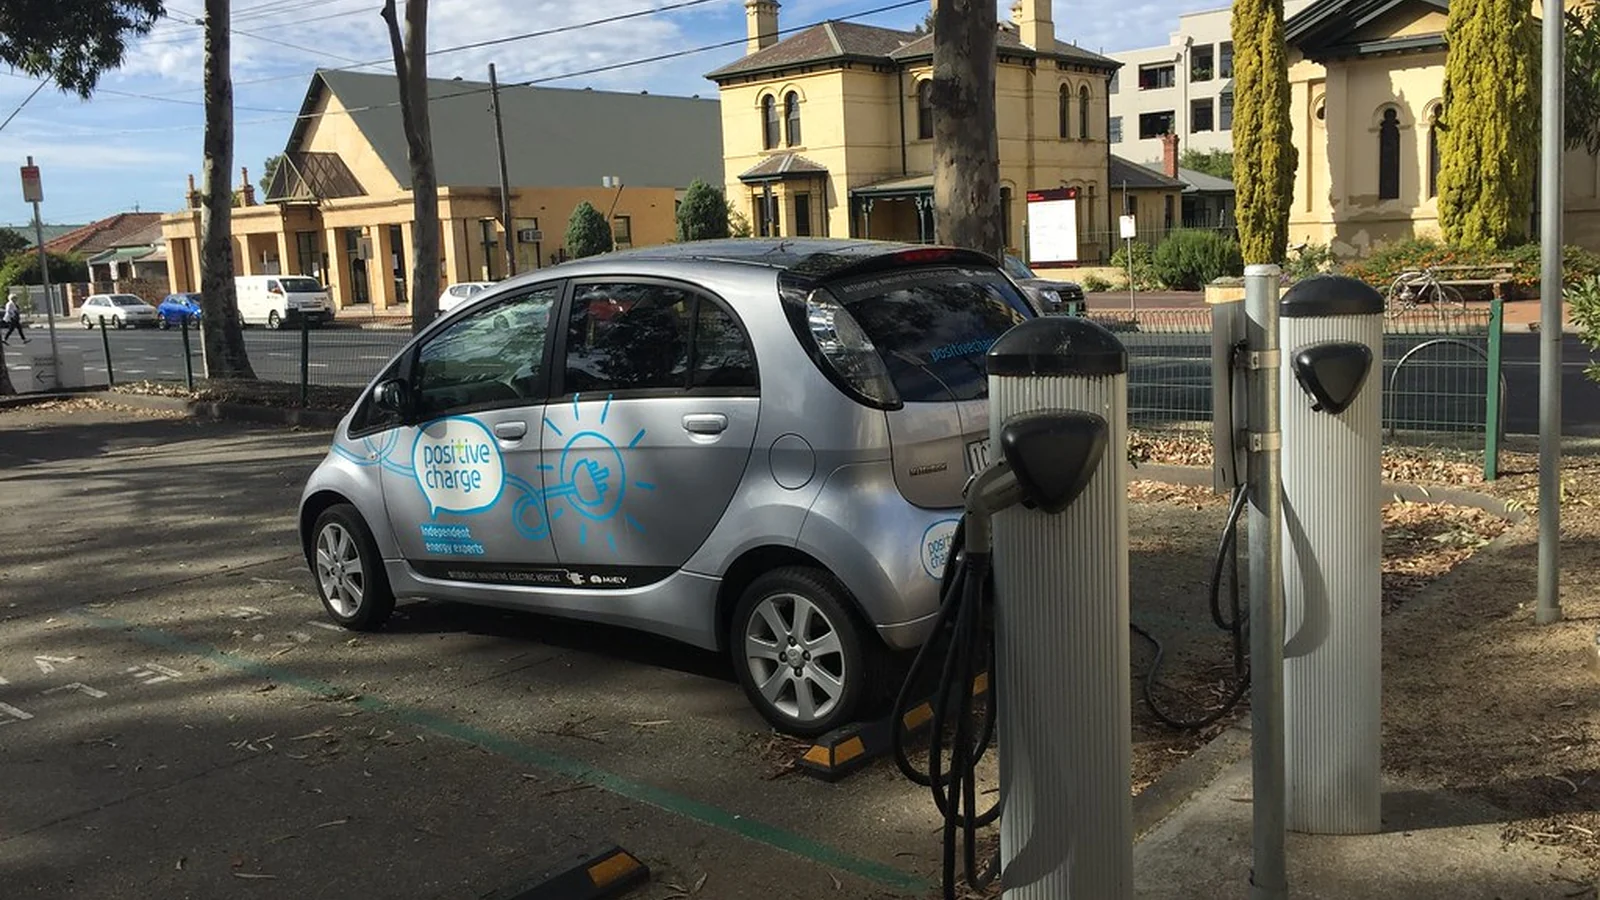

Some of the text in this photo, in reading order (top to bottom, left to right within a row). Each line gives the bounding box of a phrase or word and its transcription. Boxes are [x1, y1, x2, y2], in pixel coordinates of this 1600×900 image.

[424, 439, 489, 465] positive
[426, 467, 481, 492] charge
[420, 526, 471, 539] Independent
[426, 542, 484, 554] energy experts
[928, 534, 953, 556] posit
